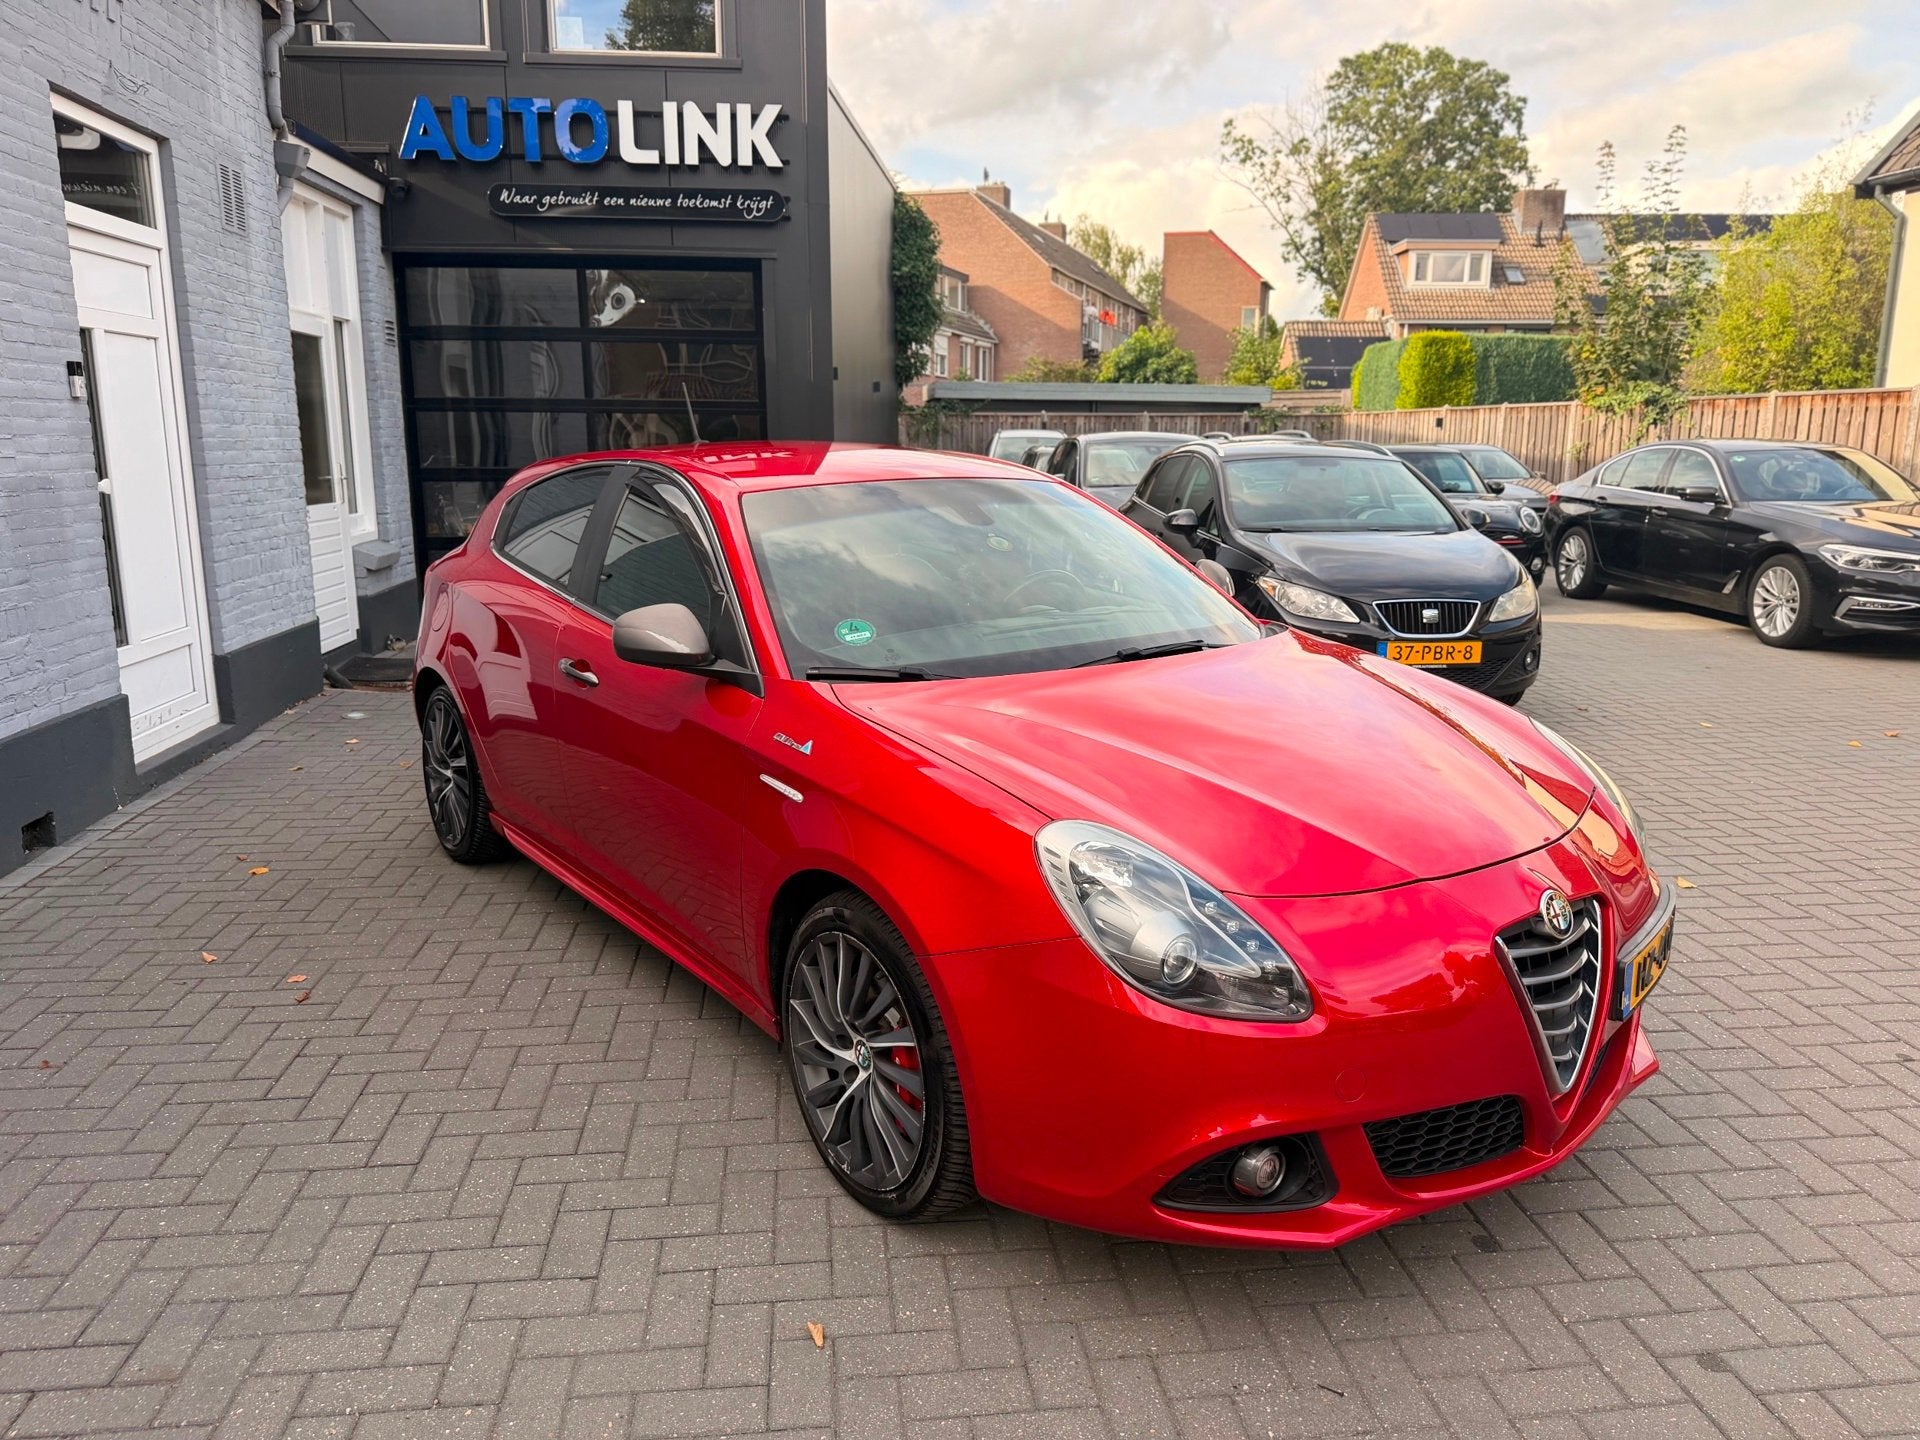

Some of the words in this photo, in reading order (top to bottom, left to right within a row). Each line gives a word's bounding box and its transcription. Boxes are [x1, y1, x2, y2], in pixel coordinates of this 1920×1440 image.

[499, 187, 537, 204] Waar
[537, 190, 600, 212] gebruikt
[603, 196, 625, 206] een
[629, 194, 672, 207] nieuwe
[677, 193, 733, 208] toekomst
[1392, 645, 1473, 661] 37-PBR-8
